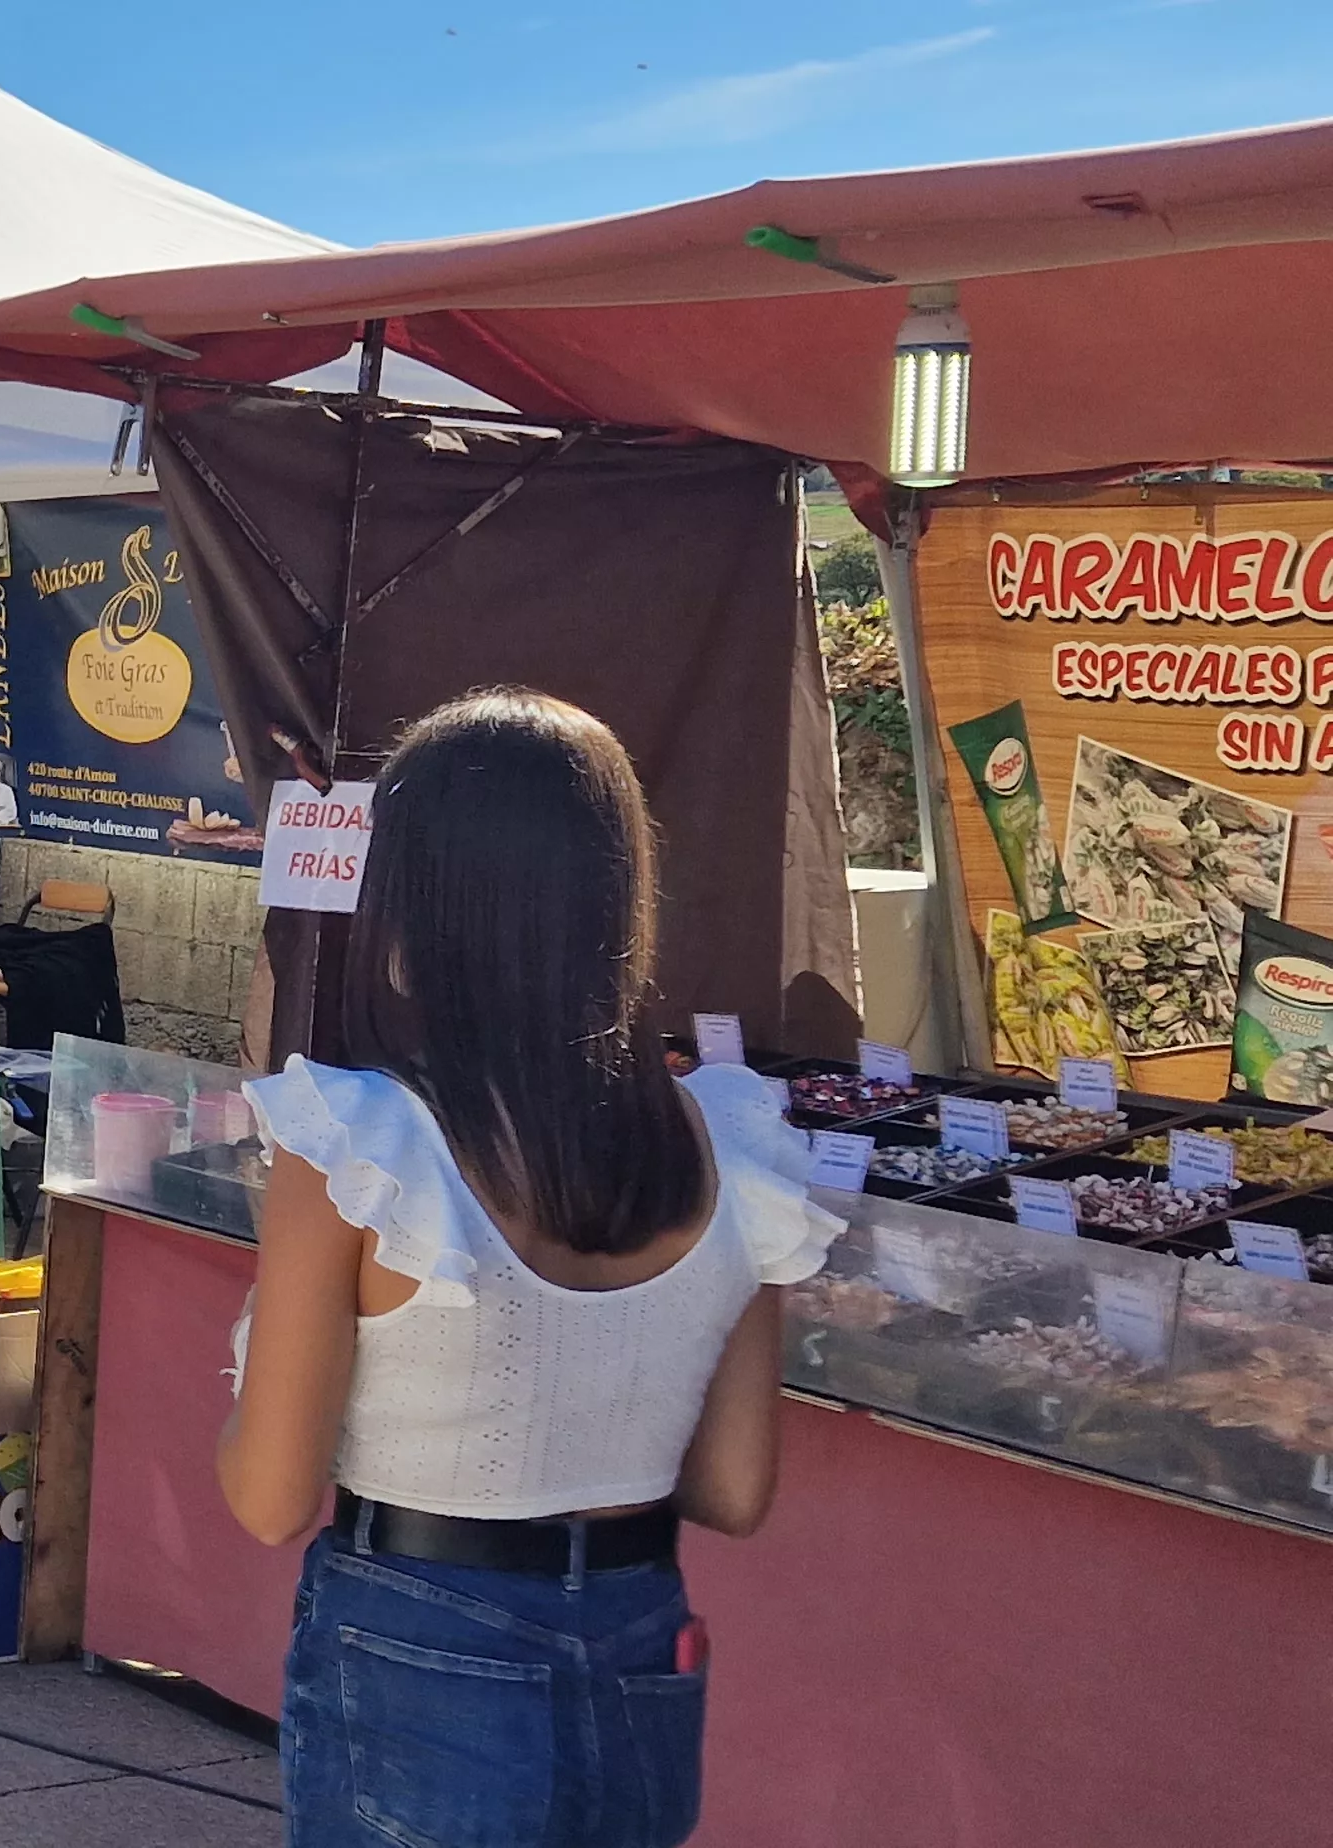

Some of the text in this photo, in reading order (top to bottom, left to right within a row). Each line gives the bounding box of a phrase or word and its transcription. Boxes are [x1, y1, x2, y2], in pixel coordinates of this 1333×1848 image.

[31, 557, 105, 600] Maison
[83, 654, 168, 692] Foie Gras
[1056, 647, 1296, 697] ESPECIALES
[106, 695, 165, 721] Tradition
[1222, 718, 1296, 764] SIN
[27, 762, 46, 777] 420
[47, 765, 74, 780] route
[28, 782, 185, 812] 40700 SAINT-CRICQ-CHALOSSE
[288, 846, 358, 881] FRÍAS
